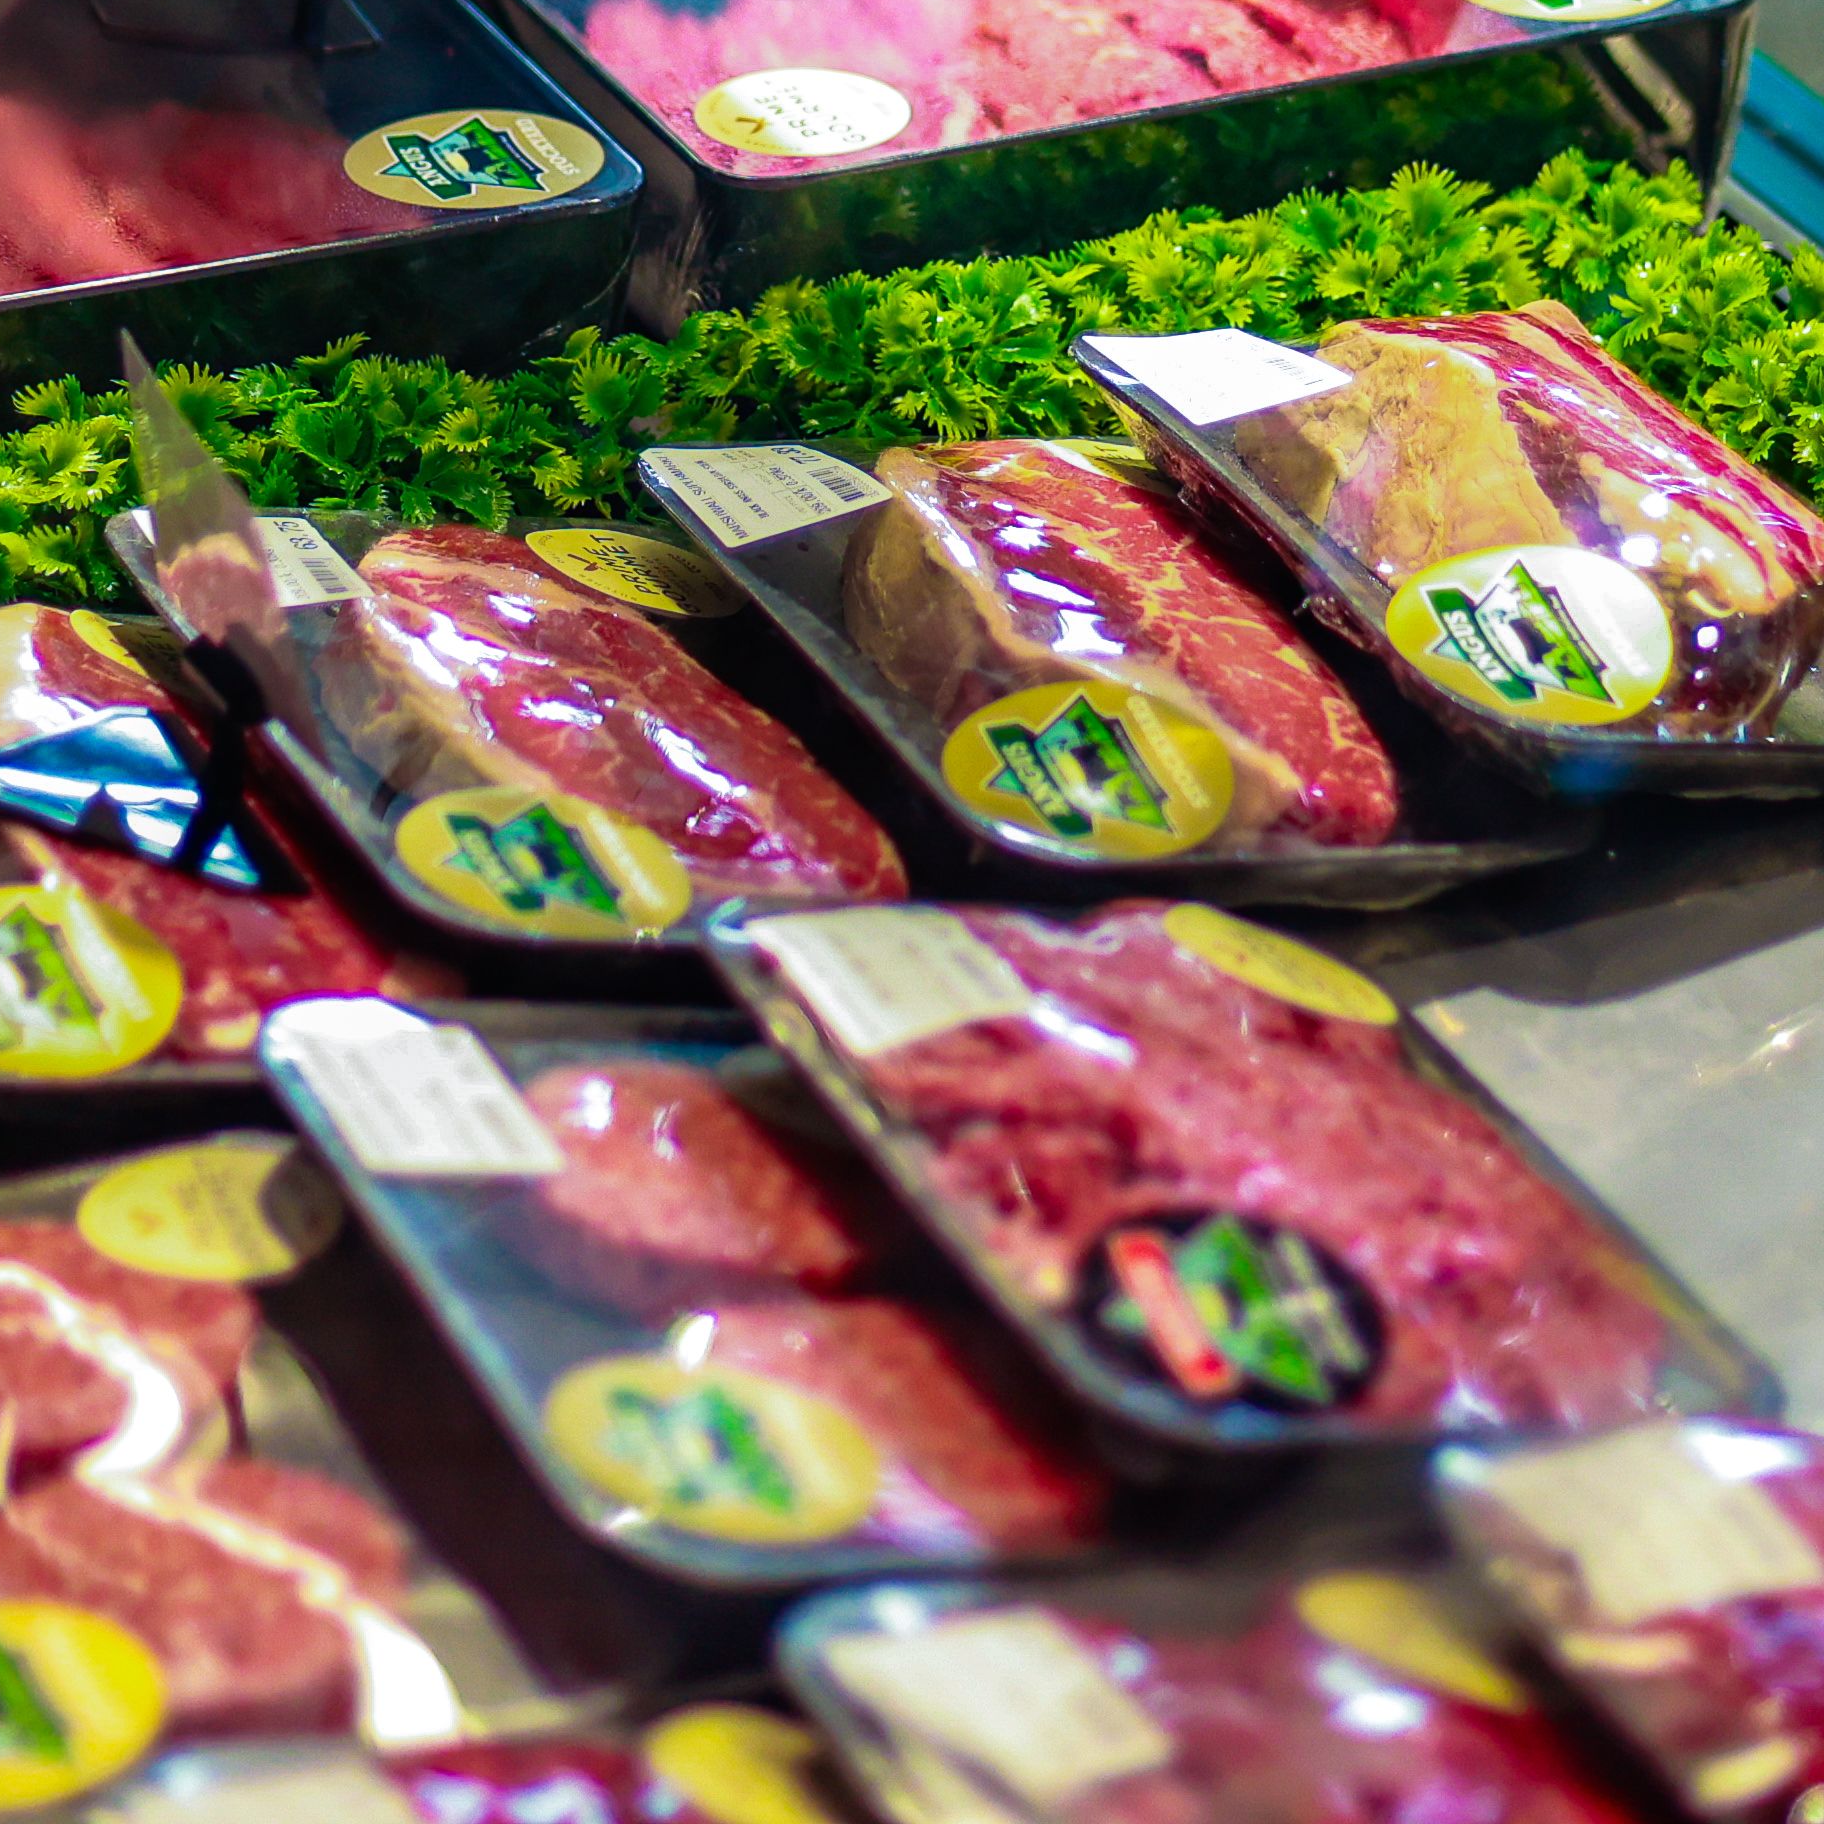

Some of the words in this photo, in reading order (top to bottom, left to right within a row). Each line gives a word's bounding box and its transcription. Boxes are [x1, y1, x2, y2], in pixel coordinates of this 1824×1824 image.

[399, 146, 452, 187] ANGUS
[272, 520, 319, 551] 63.75
[582, 546, 661, 595] PRIME
[589, 533, 702, 614] GOURMET
[1441, 609, 1513, 682] ANGUS
[1002, 740, 1070, 817] ANGUS
